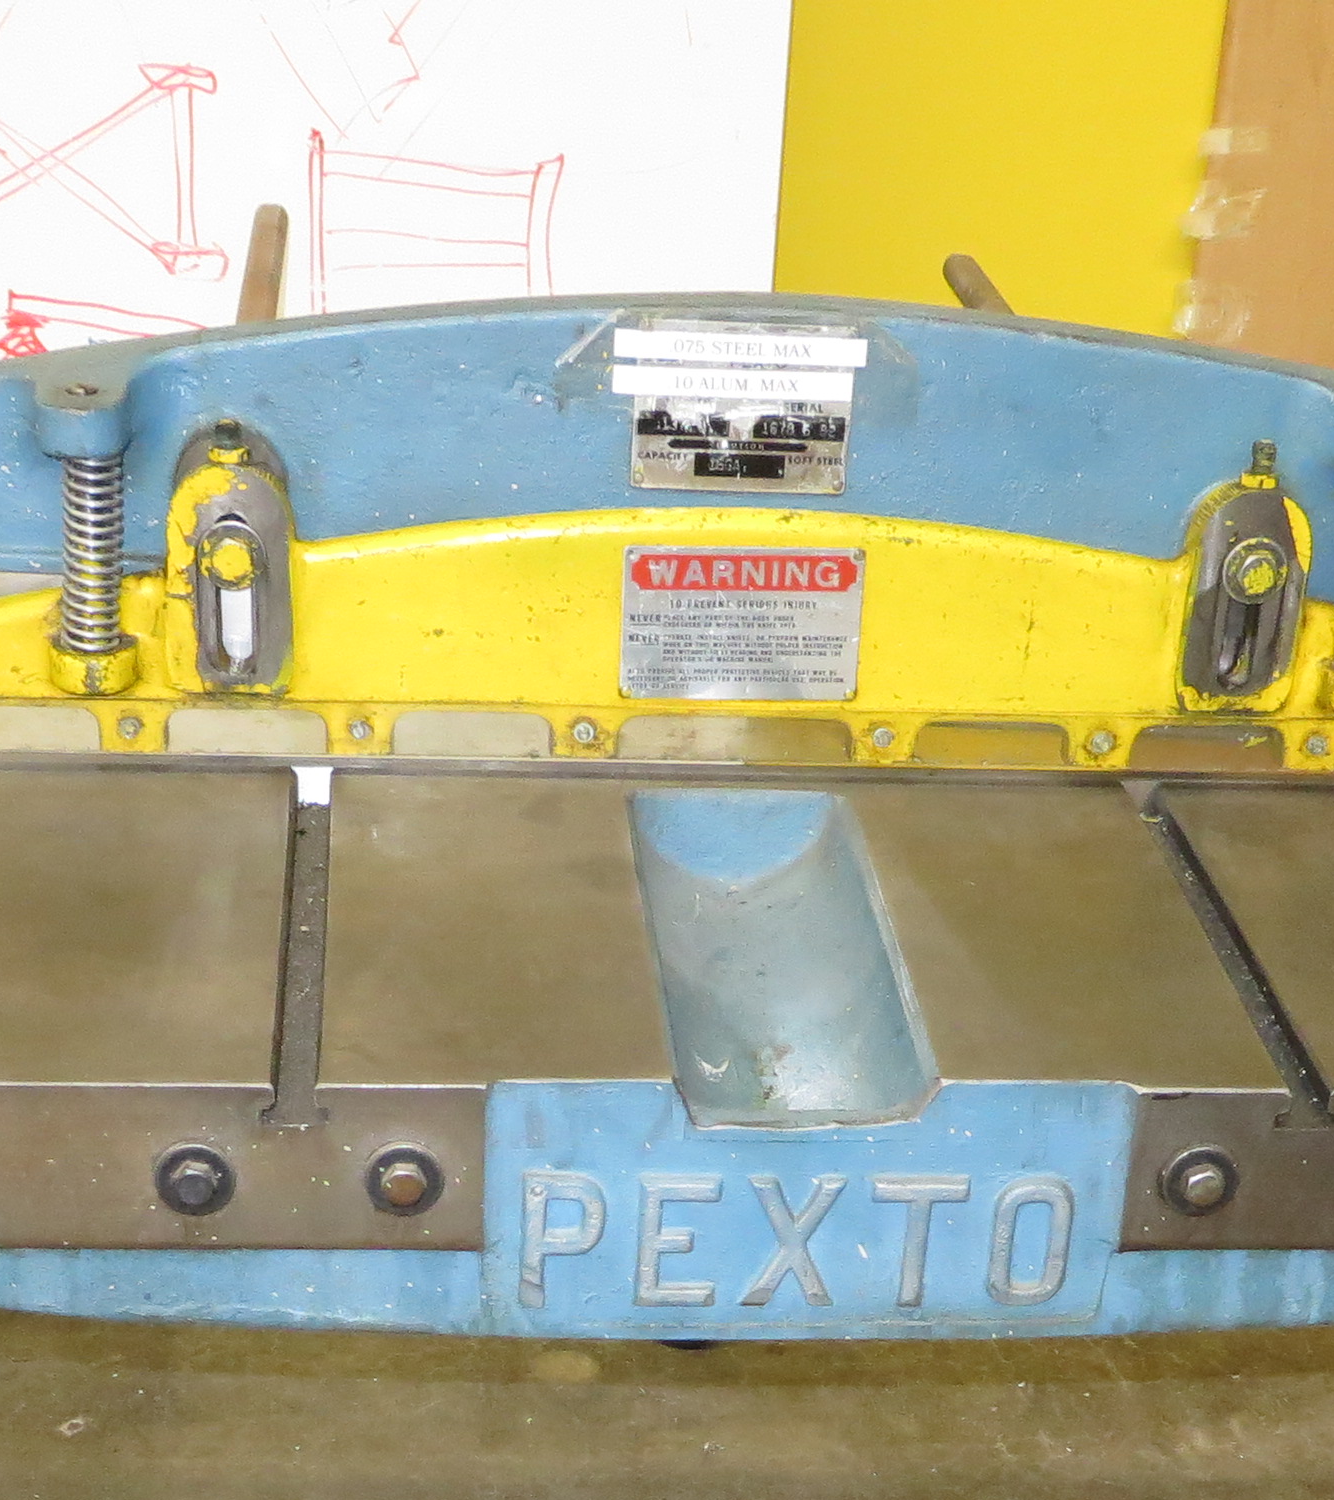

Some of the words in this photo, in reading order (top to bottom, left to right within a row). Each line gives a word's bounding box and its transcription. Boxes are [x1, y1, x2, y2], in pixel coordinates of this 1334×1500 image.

[670, 338, 704, 354] .075
[711, 340, 766, 357] STEEL
[773, 343, 812, 358] MAX
[668, 375, 694, 390] .10
[700, 376, 754, 392] ALUM.
[760, 378, 799, 393] MAX
[783, 402, 823, 414] SERIAL
[637, 449, 697, 461] CAPACITY
[788, 456, 812, 465] SOFT
[816, 457, 844, 466] STEEL
[648, 559, 842, 588] WARNING
[688, 599, 730, 609] PREVENT
[736, 600, 778, 609] SERIOUS
[783, 600, 818, 609] INJURY
[629, 614, 662, 622] NEVER
[628, 634, 659, 642] NEVER
[518, 1169, 1076, 1308] PEXTO
